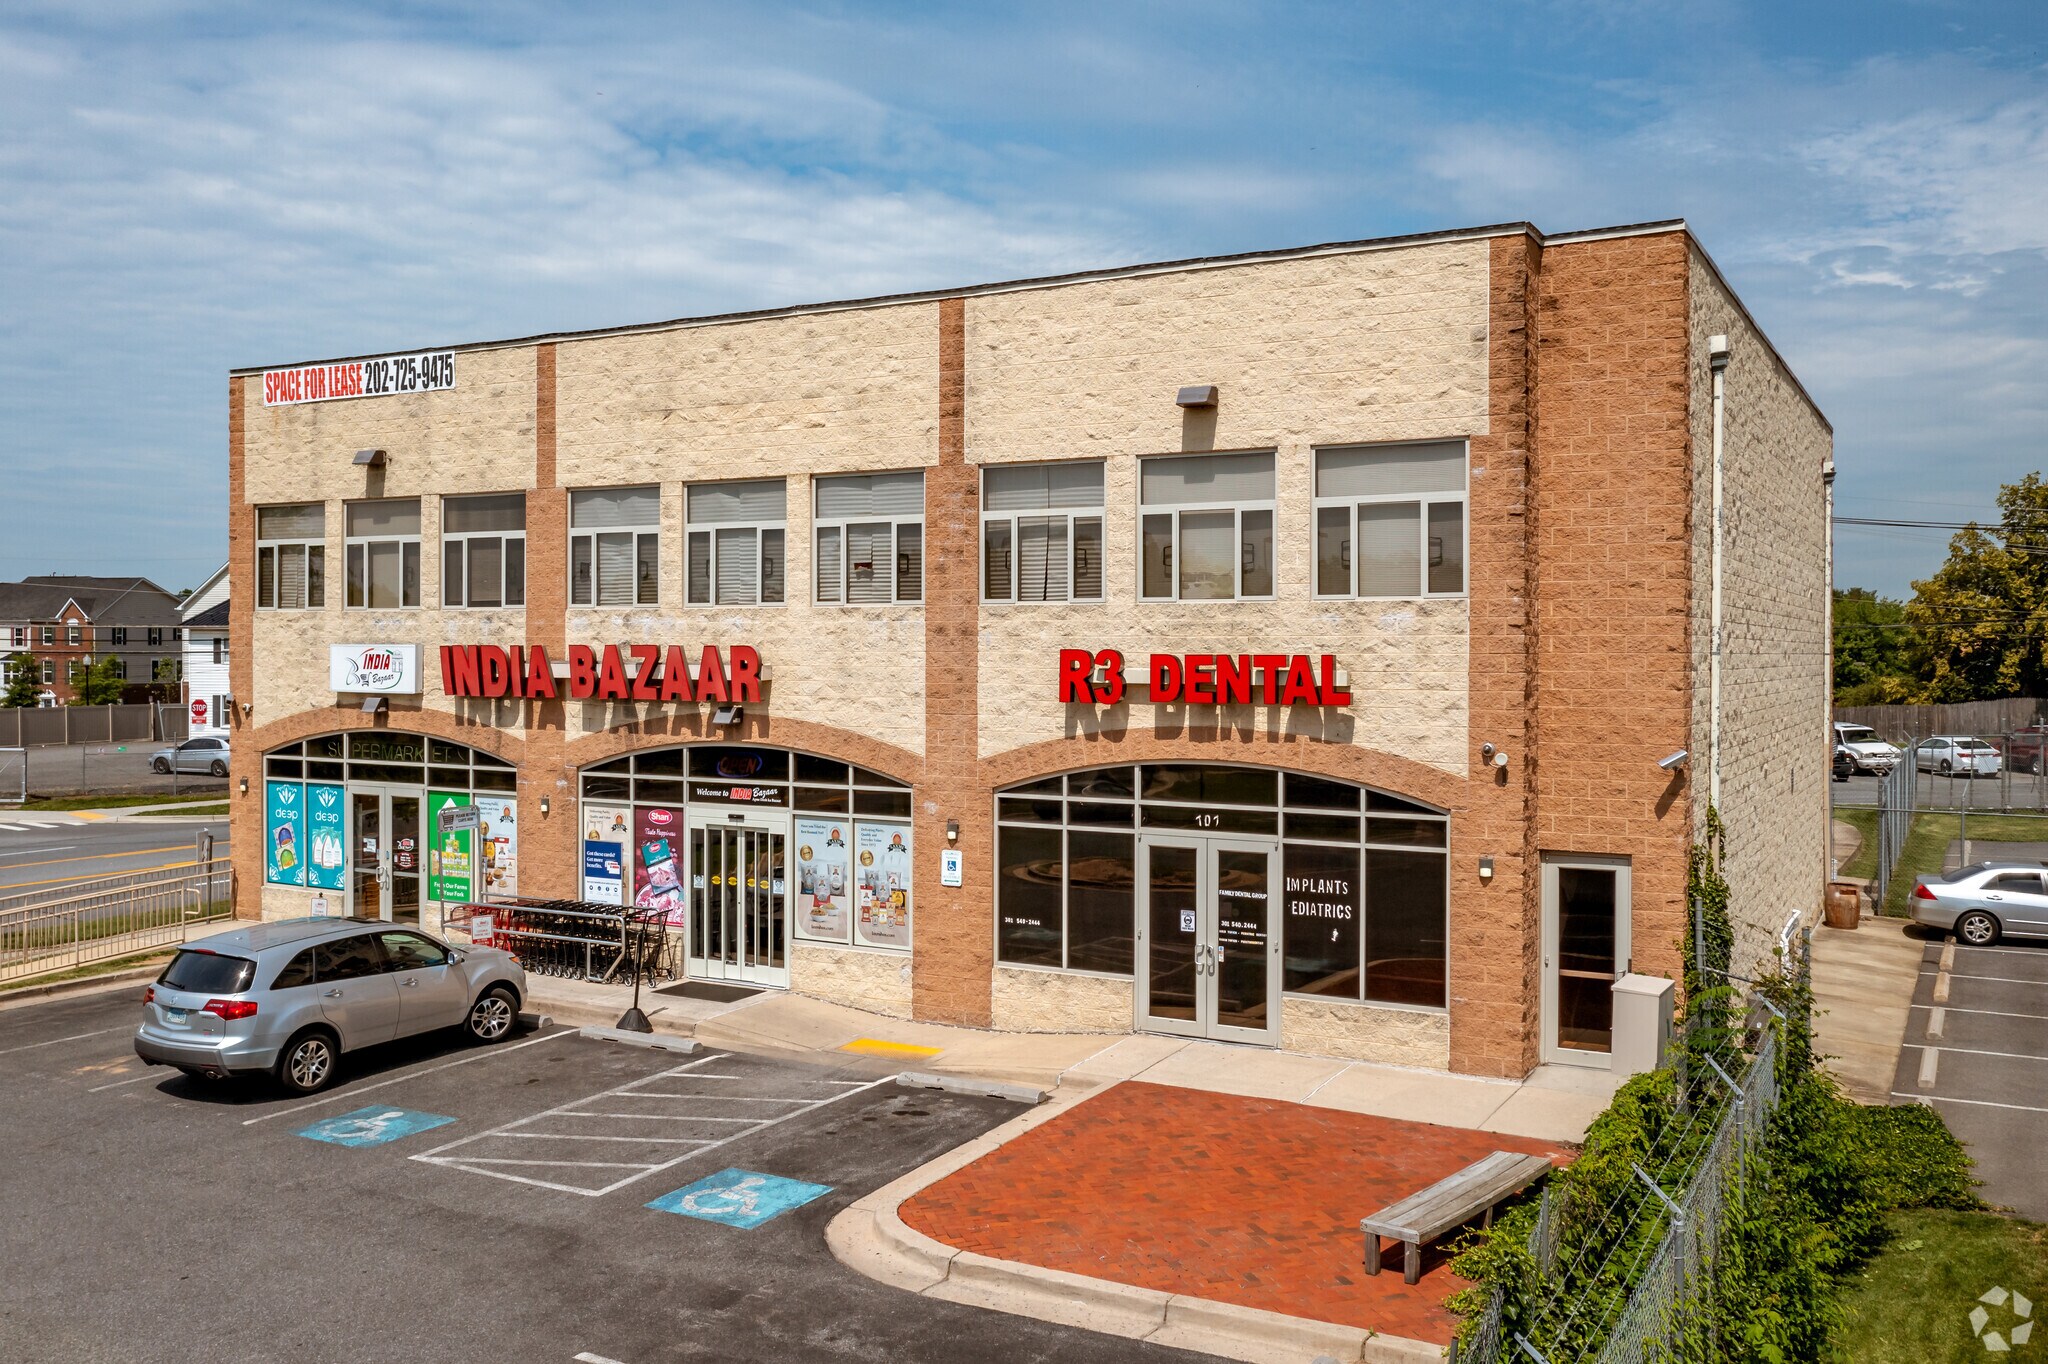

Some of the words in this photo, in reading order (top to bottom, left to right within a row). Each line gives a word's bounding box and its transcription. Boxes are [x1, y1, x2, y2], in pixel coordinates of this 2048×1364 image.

[266, 370, 300, 403] SPACE
[304, 368, 326, 400] FOR
[328, 364, 362, 397] LEASE
[365, 353, 453, 394] 202-725-9475
[363, 653, 391, 670] INDIA
[372, 673, 394, 685] Bazaar
[440, 645, 557, 698] INDIA
[568, 645, 762, 702] BAZAAR
[1059, 649, 1125, 705] R3
[1150, 654, 1352, 705] DENTAL
[696, 788, 722, 796] Welcome
[730, 787, 752, 800] INDIA
[752, 787, 778, 798] Bazaar
[275, 807, 298, 821] deep
[315, 810, 339, 824] deep
[651, 812, 669, 821] Shan
[1195, 814, 1219, 827] 101
[1286, 877, 1348, 894] IMPLANTS
